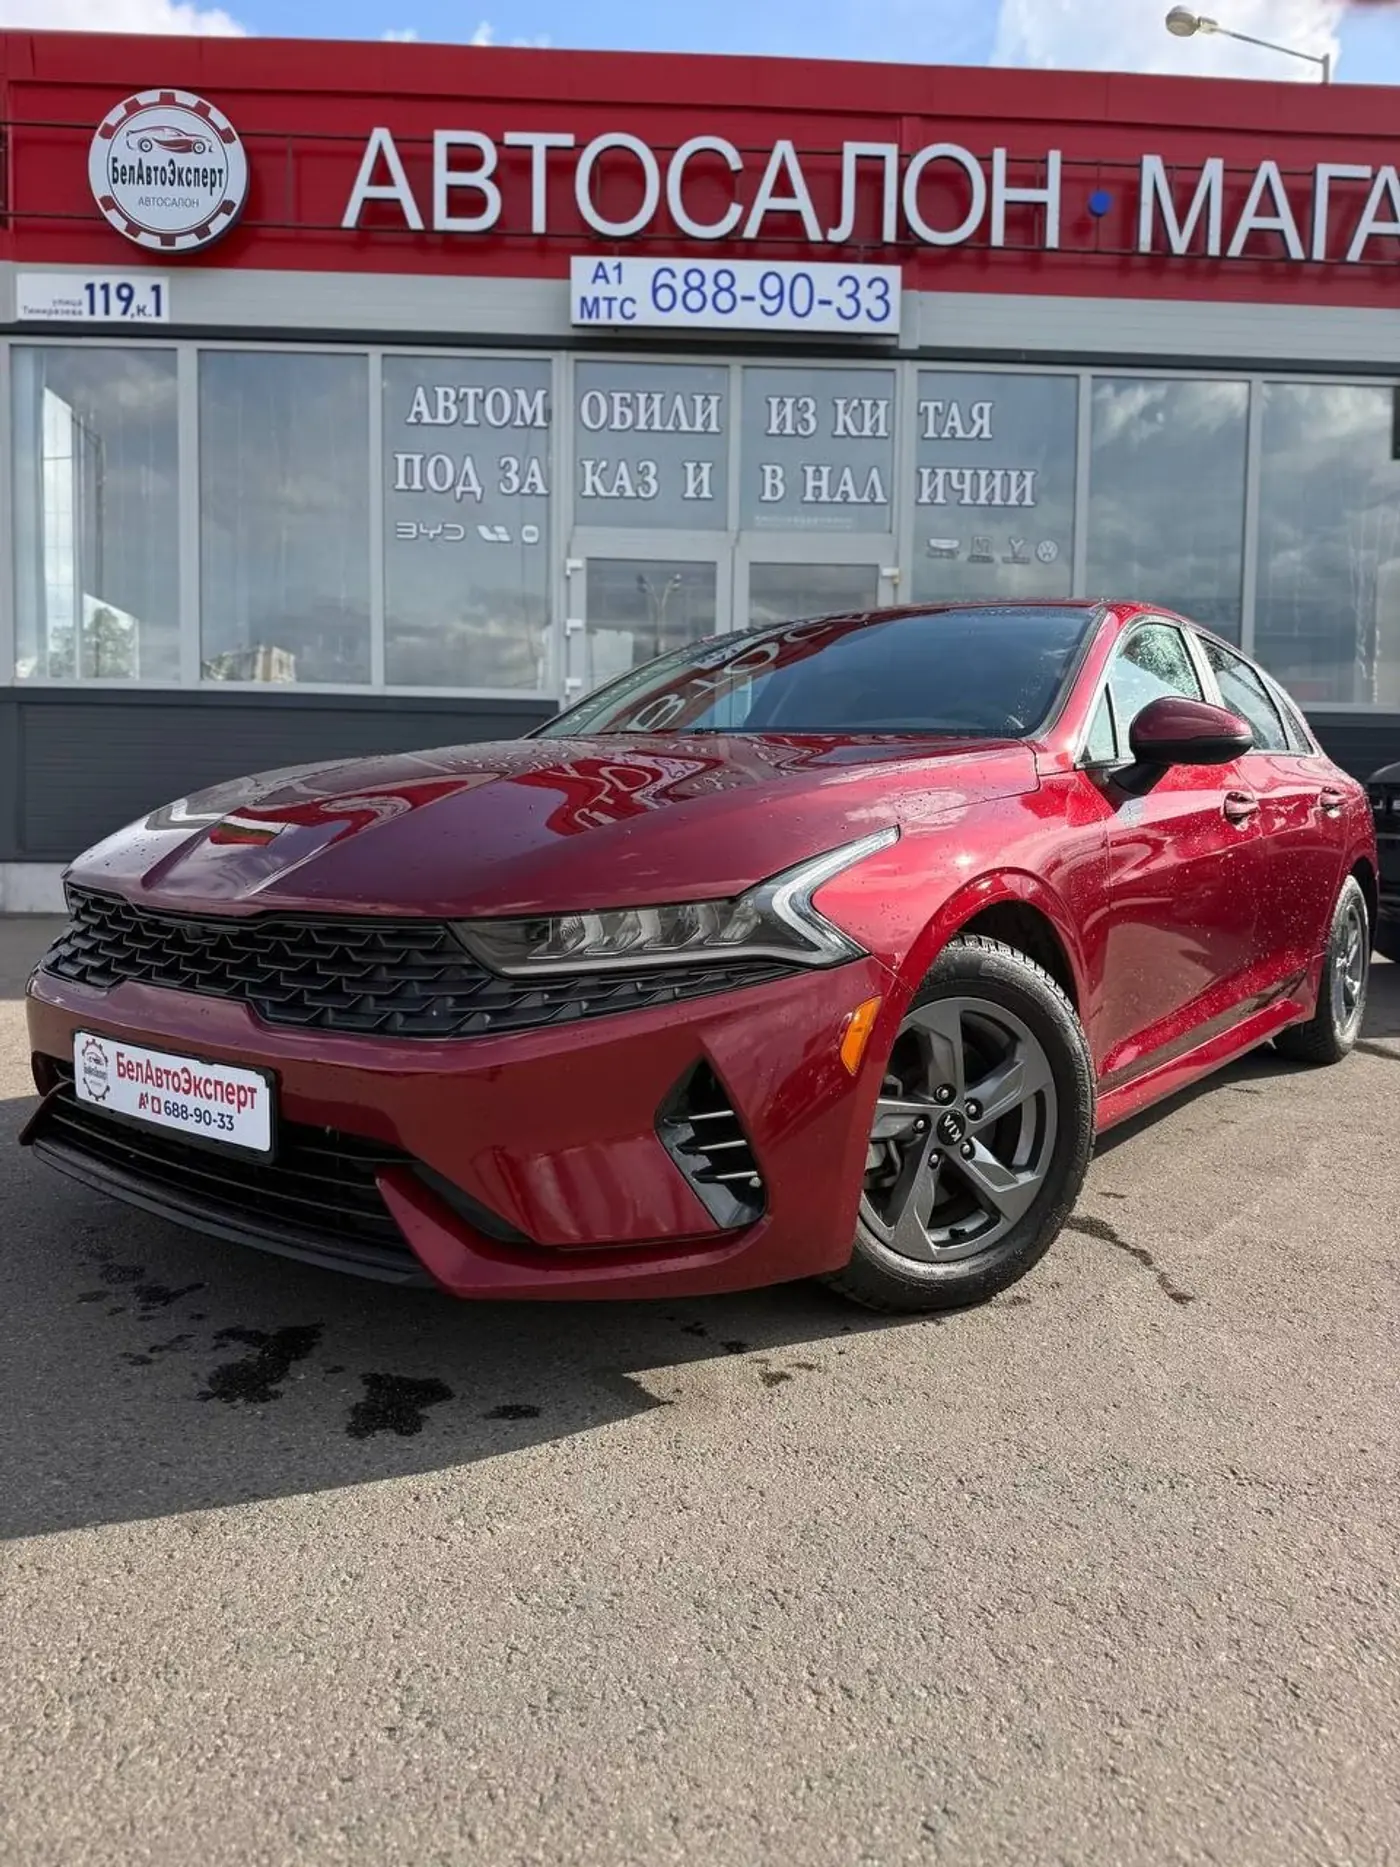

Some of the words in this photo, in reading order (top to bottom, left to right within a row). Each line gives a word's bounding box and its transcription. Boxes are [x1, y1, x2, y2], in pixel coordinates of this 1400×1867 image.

[111, 157, 224, 196] БелАвтоЭксперт
[341, 127, 1061, 249] АВТОСАЛОН
[138, 196, 200, 208] АВТОСАЛОН
[579, 296, 637, 320] МТС
[651, 267, 891, 322] 688-90-33
[766, 397, 817, 437] ИЗ
[394, 453, 483, 502] ПОД
[683, 462, 713, 499] И
[761, 465, 785, 501] В
[116, 1052, 257, 1113] БелАвтоЭксперт
[163, 1100, 235, 1131] 688-90-33
[944, 1114, 962, 1142] KIA
